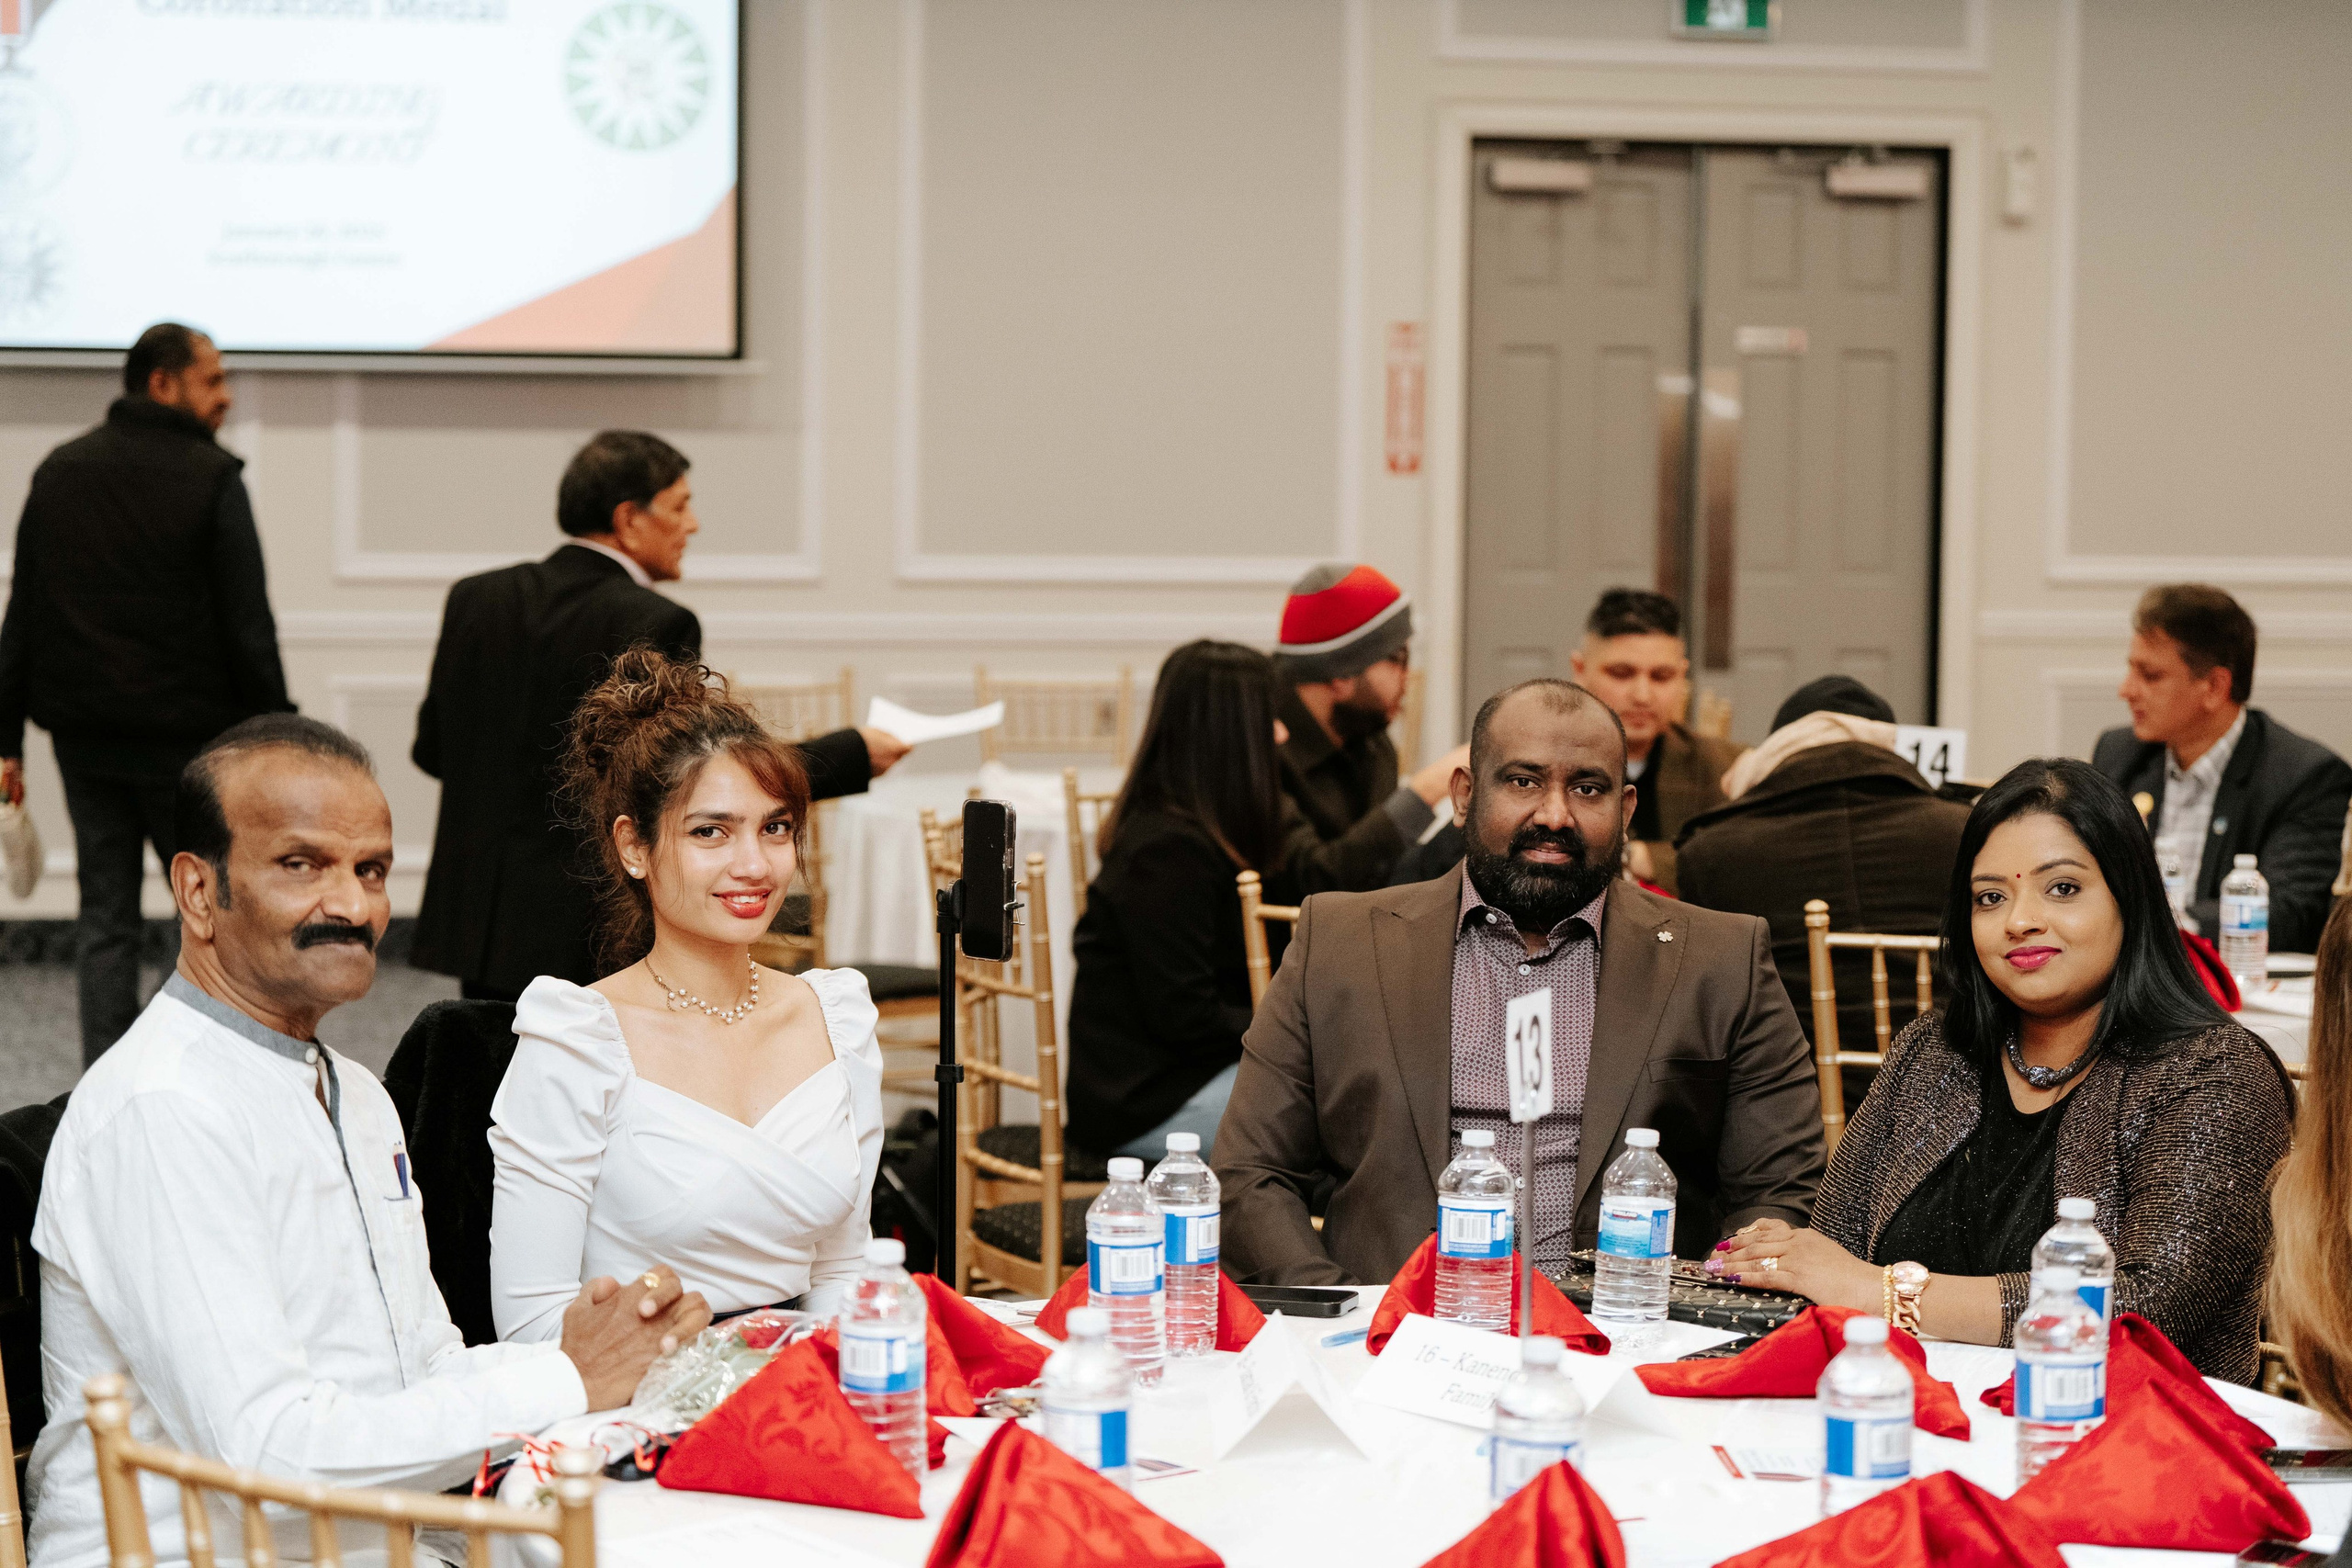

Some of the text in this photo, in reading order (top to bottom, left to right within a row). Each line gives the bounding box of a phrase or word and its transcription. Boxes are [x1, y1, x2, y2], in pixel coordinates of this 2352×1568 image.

[1910, 740, 1949, 782] 14
[1514, 1014, 1543, 1090] 13
[1415, 1344, 1440, 1363] 16
[1453, 1351, 1522, 1383] Kanen
[1441, 1382, 1498, 1415] Family
